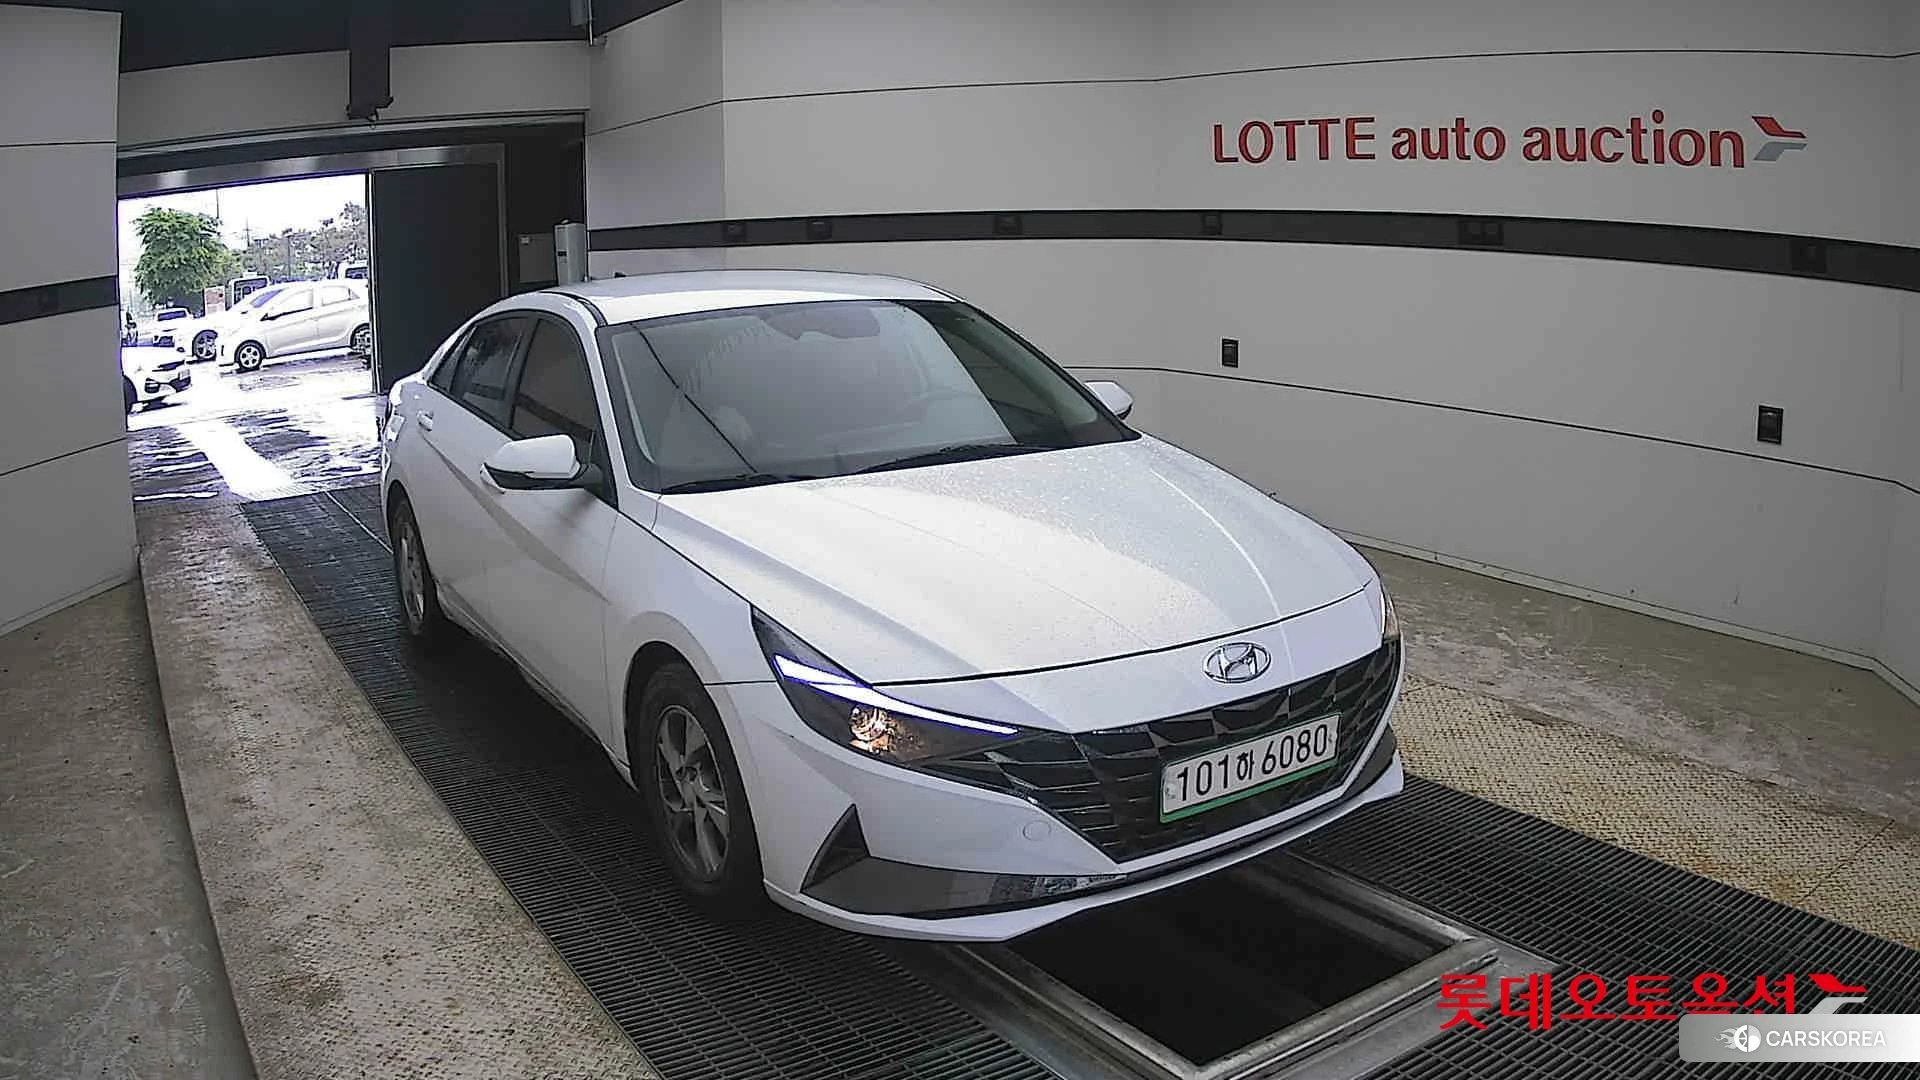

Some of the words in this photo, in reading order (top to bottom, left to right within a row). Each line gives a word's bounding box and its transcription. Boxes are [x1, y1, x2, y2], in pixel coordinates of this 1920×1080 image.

[1213, 117, 1376, 164] LOTTE
[1391, 118, 1506, 161] auto
[1522, 109, 1745, 168] auction
